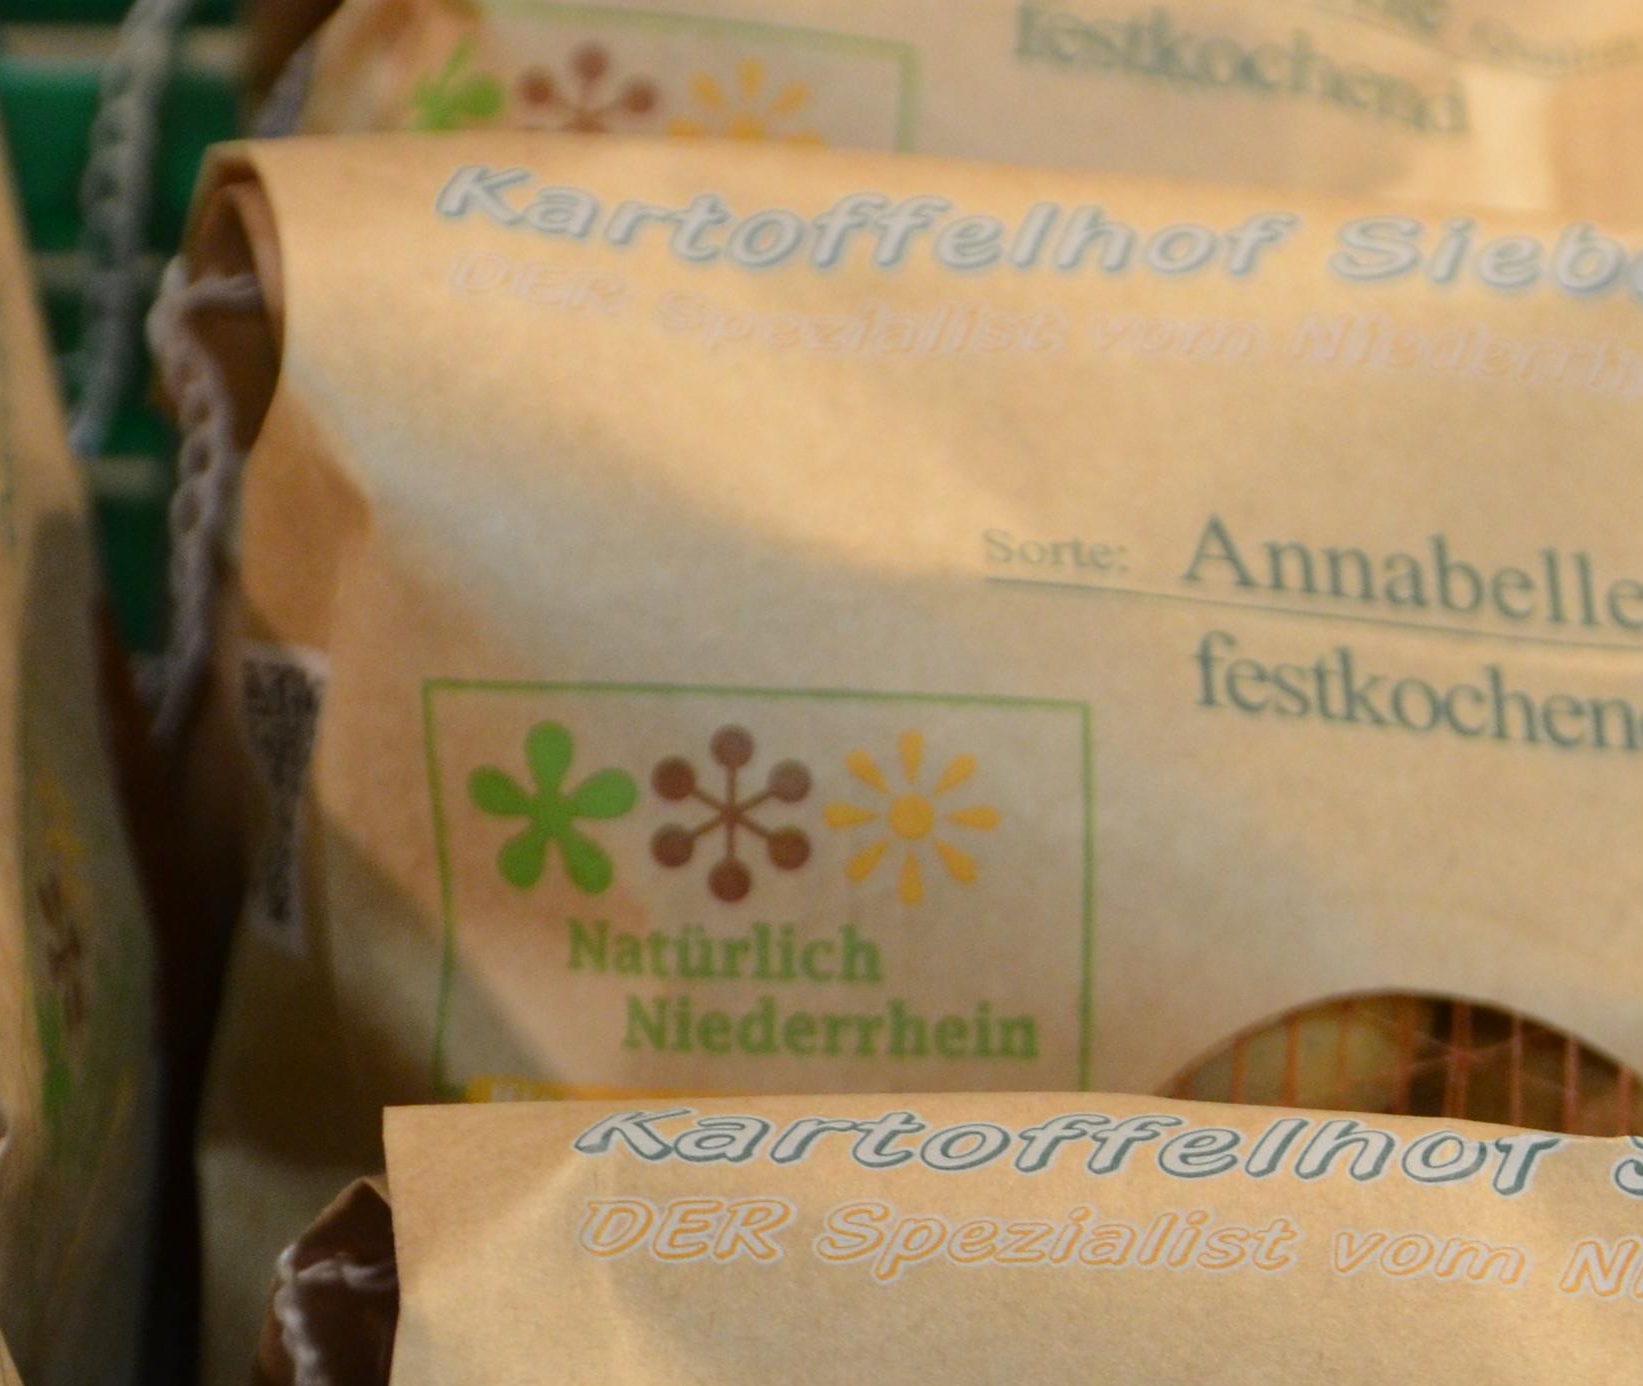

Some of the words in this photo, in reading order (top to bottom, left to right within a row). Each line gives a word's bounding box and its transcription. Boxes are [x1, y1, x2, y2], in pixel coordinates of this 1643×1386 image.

[434, 164, 1298, 278] Kartoffelhof
[448, 251, 630, 318] DER
[981, 527, 1130, 574] Sorte:
[566, 918, 884, 984] Natürlich
[622, 996, 1040, 1060] Niederrhein
[572, 1106, 1562, 1197] Kartoffelhof
[580, 1198, 791, 1262] DER
[815, 1200, 1299, 1282] Spezialist
[1333, 1224, 1527, 1287] vom
